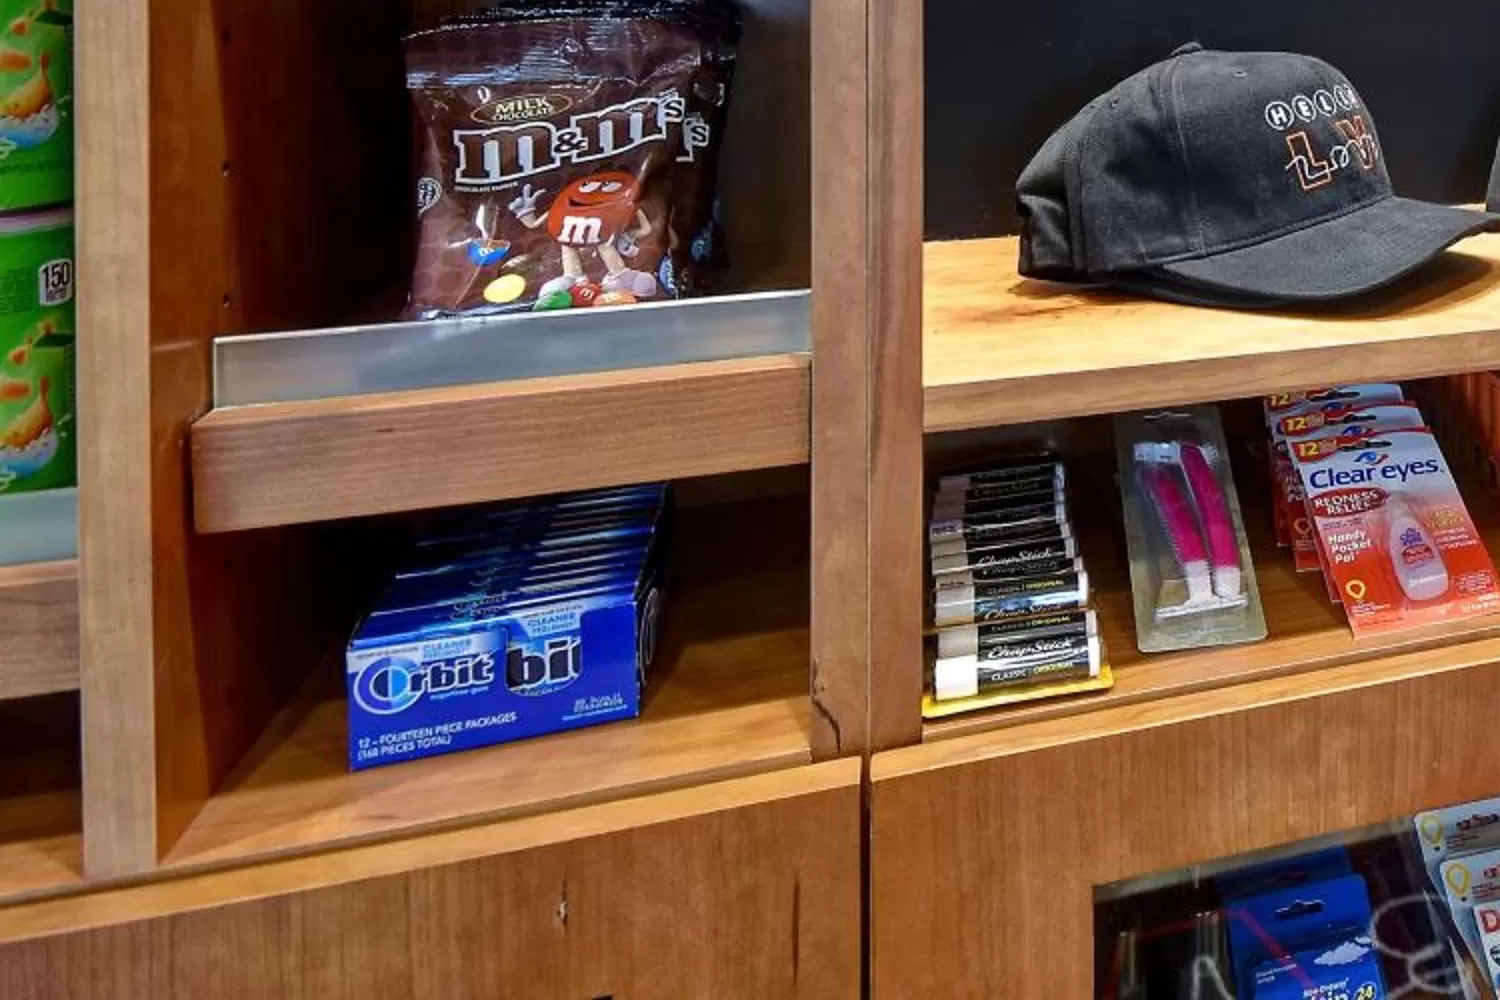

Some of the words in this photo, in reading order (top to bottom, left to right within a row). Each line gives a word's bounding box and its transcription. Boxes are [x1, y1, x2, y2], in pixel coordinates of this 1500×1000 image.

[495, 95, 555, 114] MILK
[1264, 83, 1361, 131] HELL
[41, 261, 71, 290] 150
[1286, 417, 1307, 431] 12
[1299, 442, 1319, 456] 12
[1309, 466, 1377, 489] Clear
[1381, 456, 1439, 482] eyes
[353, 650, 496, 715] Orbit
[379, 727, 434, 746] FOURTEEN
[465, 711, 518, 730] PACKAGES
